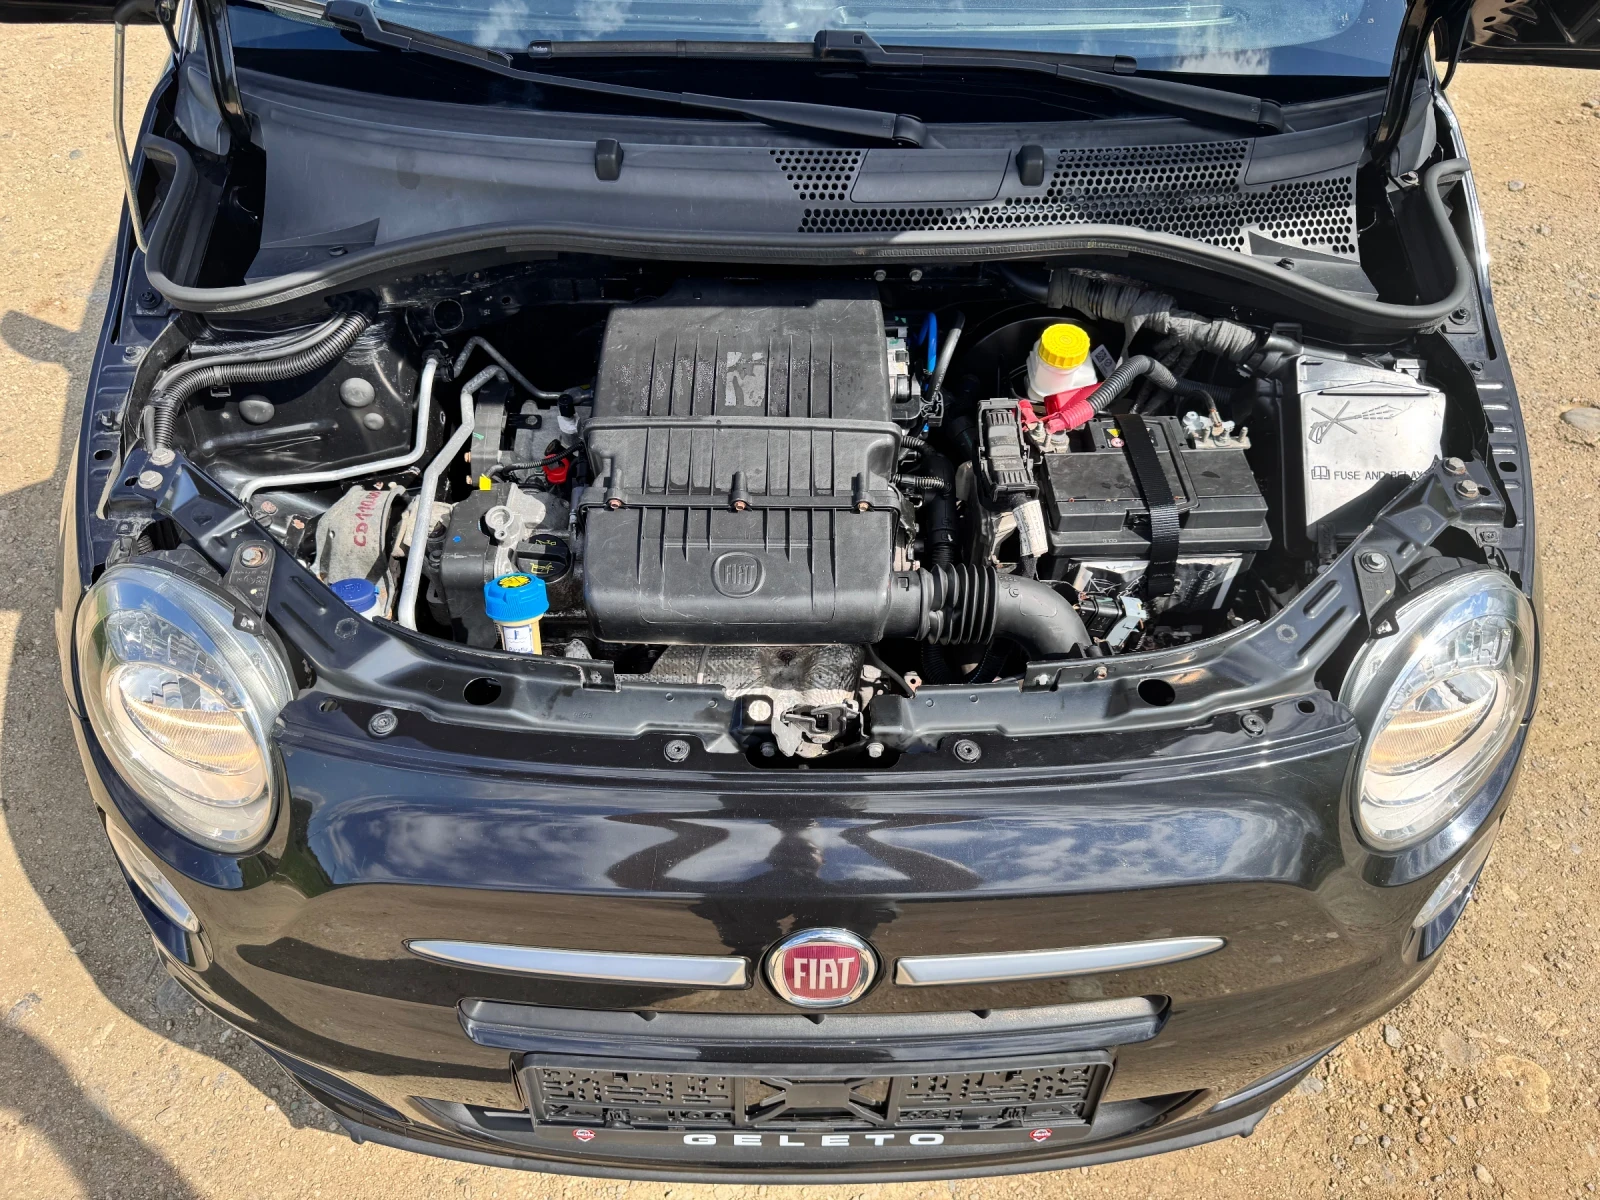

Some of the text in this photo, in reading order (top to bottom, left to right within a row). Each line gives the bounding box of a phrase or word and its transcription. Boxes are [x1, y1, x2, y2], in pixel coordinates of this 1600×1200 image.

[1333, 470, 1361, 480] FUSE
[1364, 470, 1386, 480] AND
[723, 564, 755, 585] FIAT
[793, 956, 856, 990] FIAT
[683, 1133, 945, 1147] GELETO
